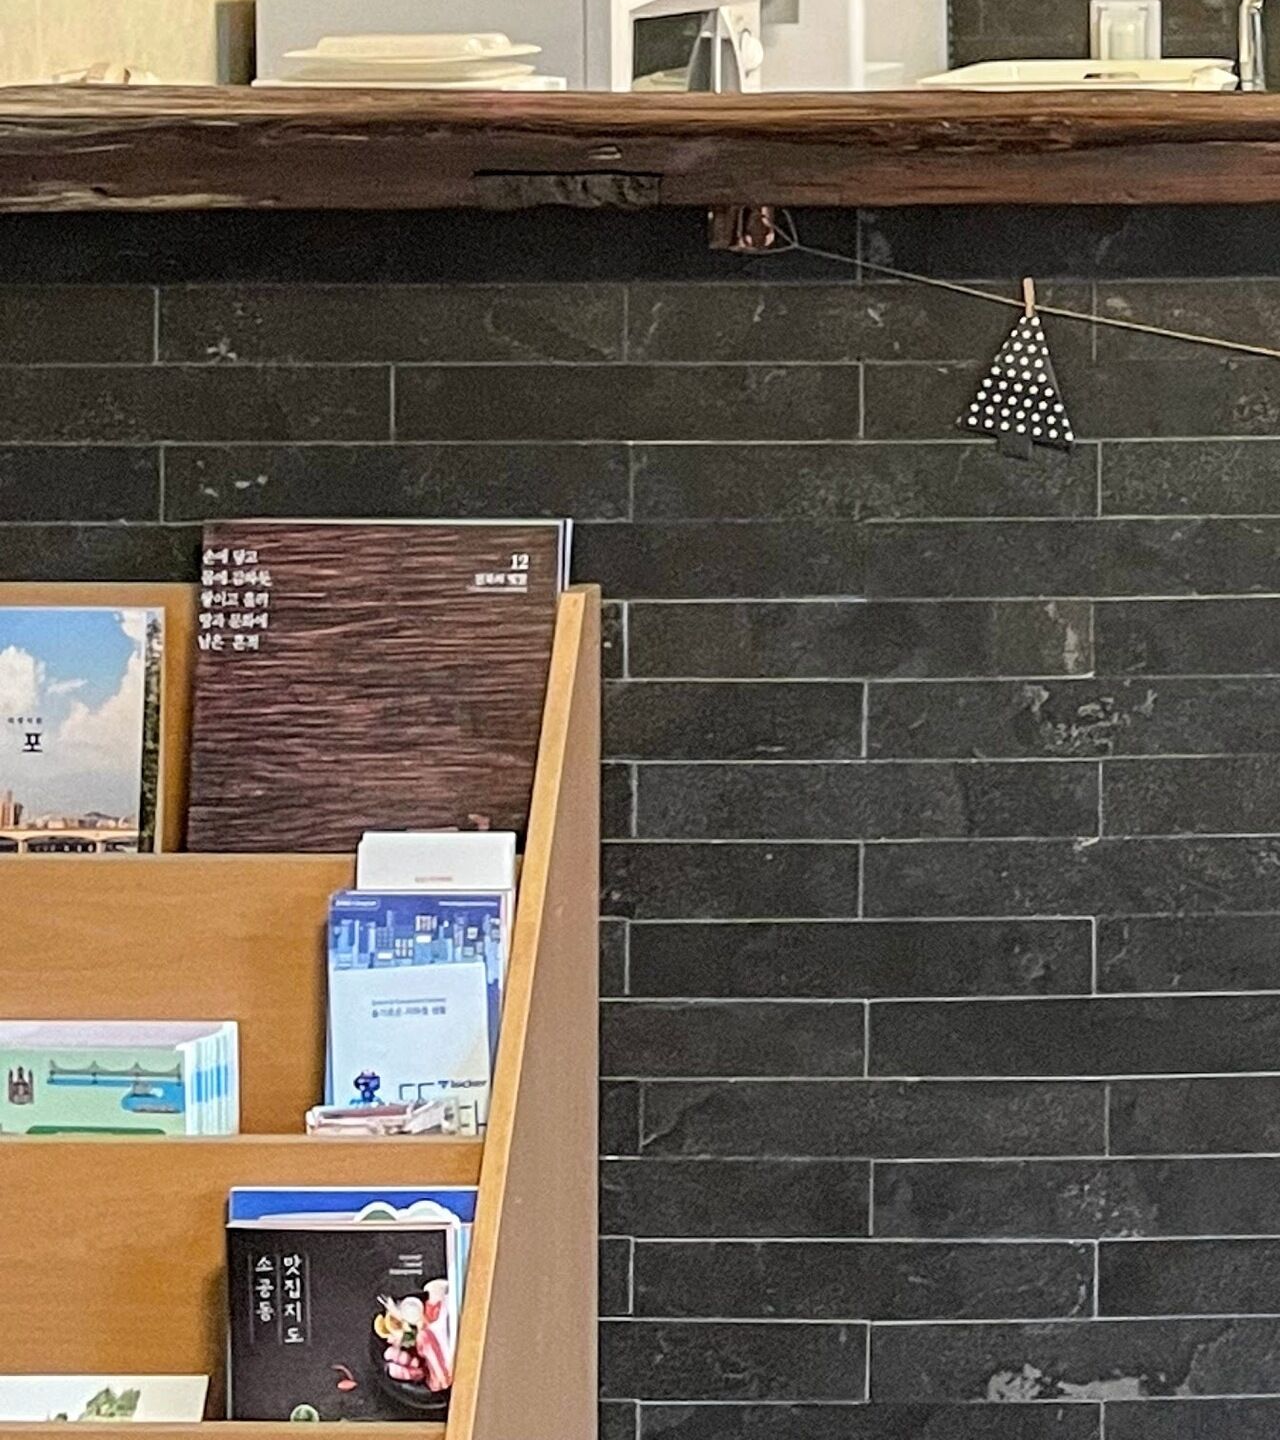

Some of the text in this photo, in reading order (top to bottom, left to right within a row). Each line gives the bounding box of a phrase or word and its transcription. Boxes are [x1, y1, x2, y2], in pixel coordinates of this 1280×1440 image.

[511, 553, 529, 570] 12
[255, 1254, 305, 1344] 소공동 맛집지도
